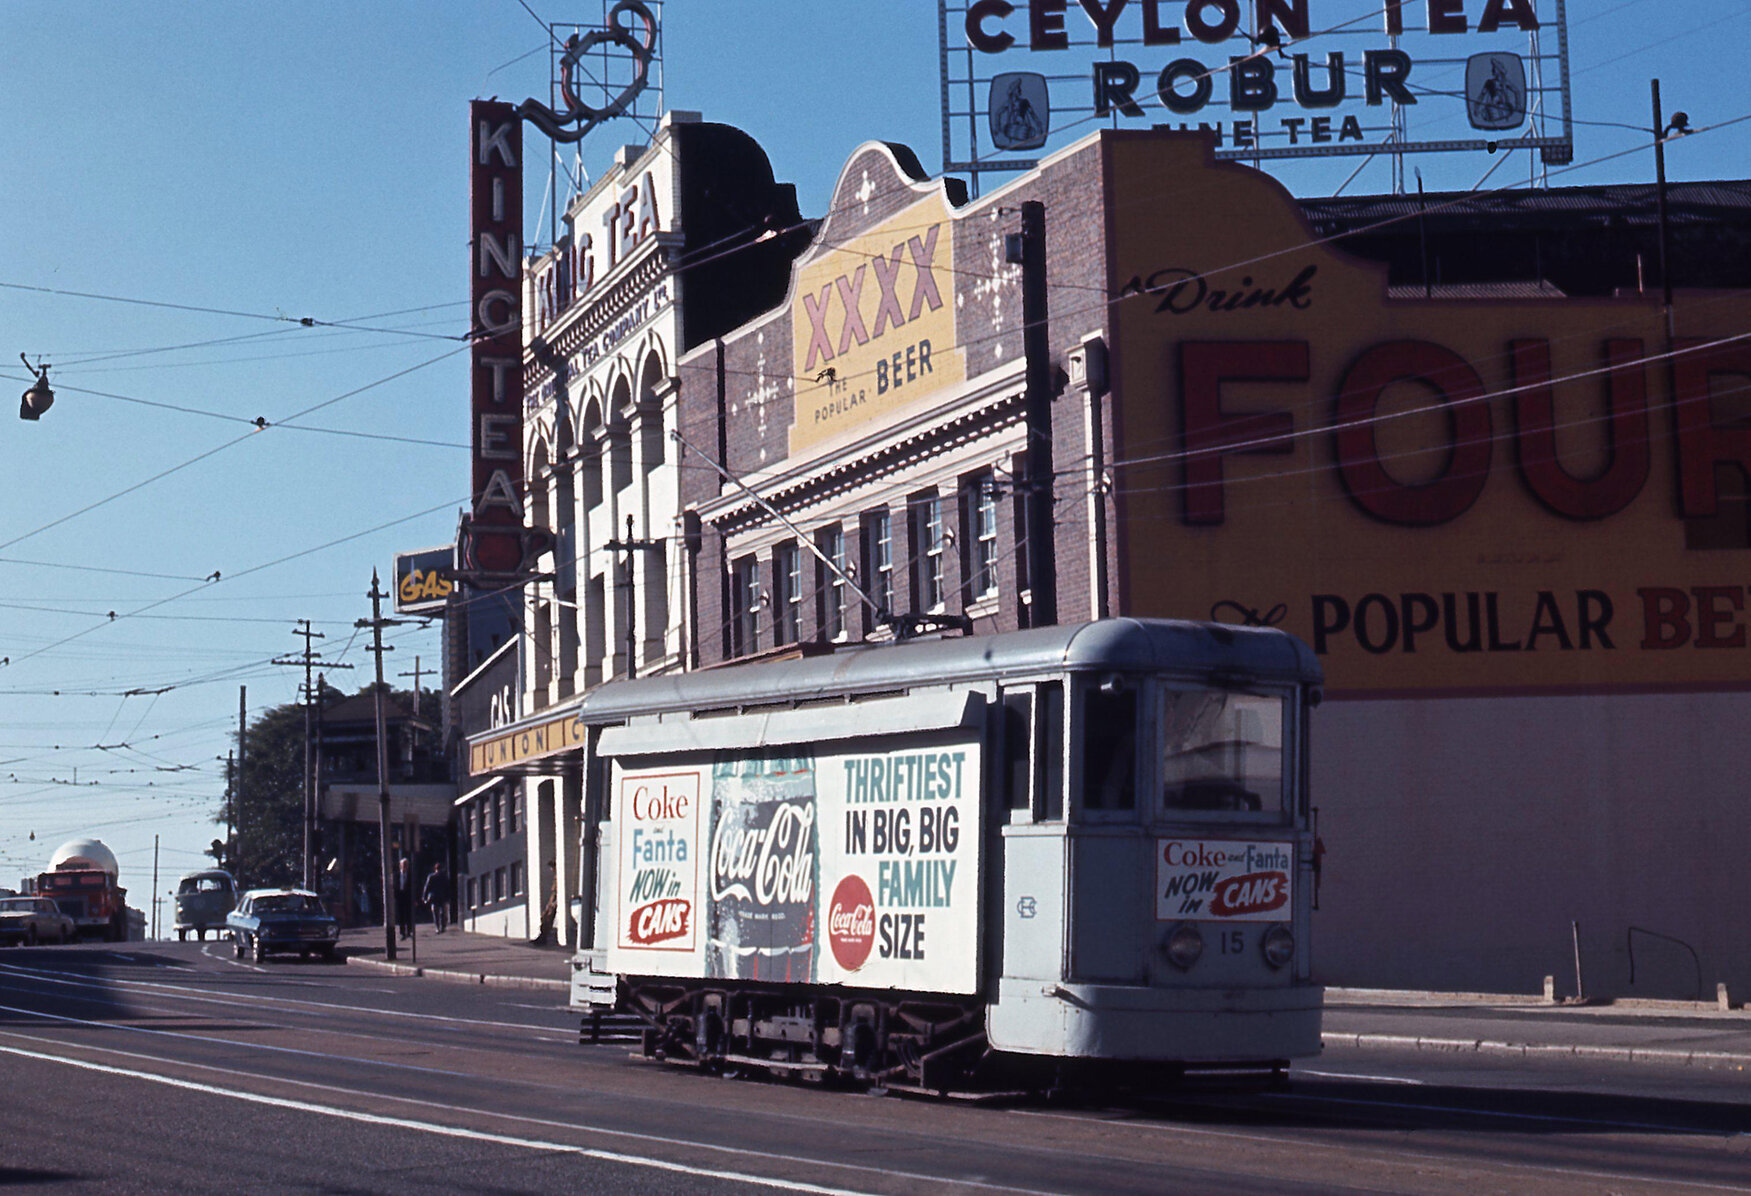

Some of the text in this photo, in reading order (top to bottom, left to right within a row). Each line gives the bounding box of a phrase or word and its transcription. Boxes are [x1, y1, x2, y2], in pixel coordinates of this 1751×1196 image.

[964, 0, 1310, 53] CEYLON
[1093, 50, 1418, 118] ROBUR
[1281, 115, 1364, 145] TEA
[602, 170, 661, 270] TEA
[802, 223, 944, 373] XXXX
[1120, 265, 1318, 315] Drink
[476, 119, 522, 518] KING TEA
[602, 298, 649, 351] COMPANY
[828, 377, 848, 397] THE
[876, 338, 934, 396] BEER
[814, 389, 867, 424] POPULAR
[1310, 590, 1616, 655] POPULAR
[1636, 585, 1751, 650] BE
[488, 729, 544, 764] UNION
[844, 751, 966, 804] THRIFTIEST
[633, 785, 689, 821] Coke
[633, 828, 688, 870] Fanta
[711, 802, 815, 905] Coca-Cola
[845, 805, 959, 857] IN BIG, BIG
[1163, 841, 1226, 868] Coke
[1246, 844, 1289, 873] Fanta
[629, 868, 682, 903] NOW in
[878, 859, 957, 909] FAMILY
[1164, 870, 1220, 899] NOW
[1223, 877, 1279, 909] CANS
[637, 902, 688, 940] CANS
[879, 913, 926, 960] SIZE
[1221, 931, 1244, 954] 15
